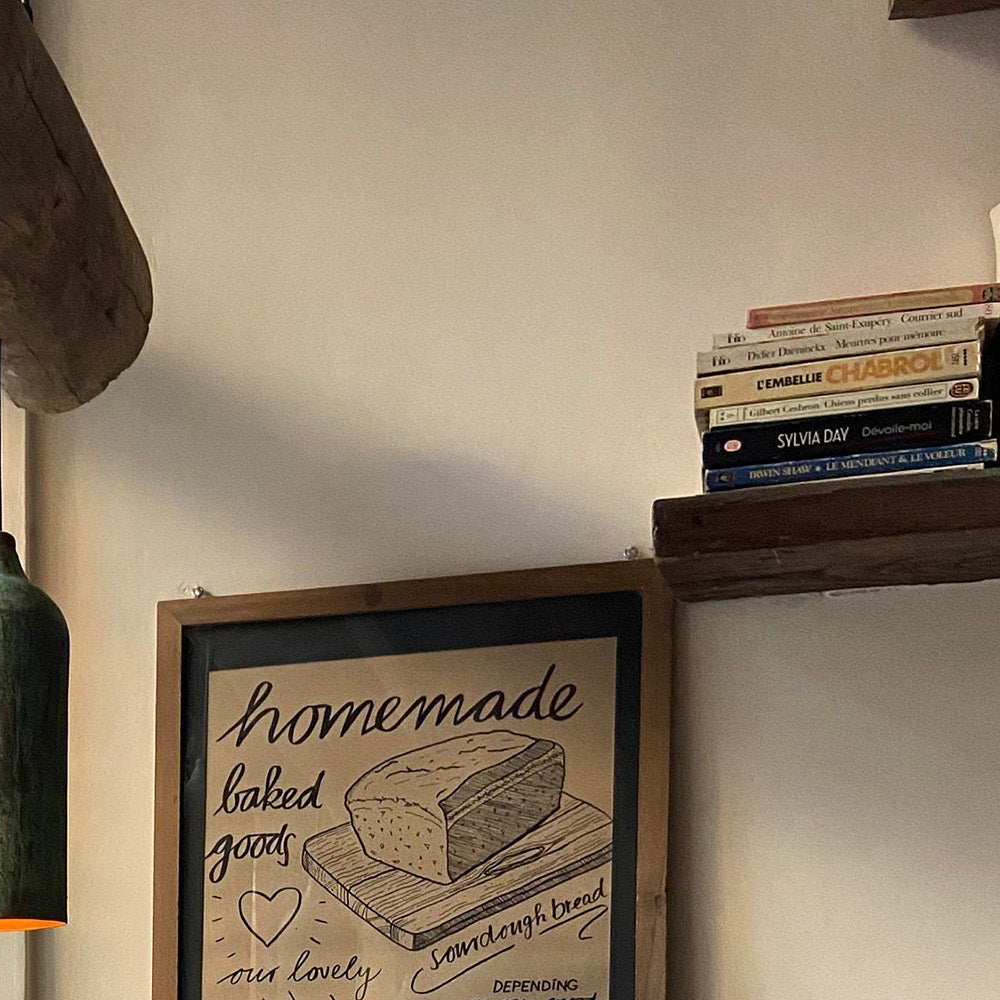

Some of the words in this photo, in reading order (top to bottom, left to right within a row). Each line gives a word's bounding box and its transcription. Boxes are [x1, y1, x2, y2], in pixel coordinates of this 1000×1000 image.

[769, 326, 805, 338] Antoine
[809, 324, 820, 335] de
[825, 318, 891, 333] Saint-Exupéry
[901, 311, 943, 323] Courrier
[946, 308, 963, 318] sud
[747, 350, 775, 361] Didier
[879, 335, 900, 346] pour
[757, 372, 823, 390] L'EMBELLIE
[825, 351, 943, 385] CHABROL
[749, 407, 780, 418] Gilbert
[824, 398, 855, 410] Chiens
[857, 392, 889, 408] perdus
[913, 387, 943, 398] collier
[777, 430, 820, 448] SYLVIA
[823, 426, 849, 443] DAY
[862, 421, 932, 437] Dévoile-moi
[749, 468, 780, 479] IRWIN
[782, 464, 812, 475] SHAW
[826, 461, 839, 471] LE
[841, 456, 895, 469] MENDIANT
[898, 455, 908, 464] &
[911, 453, 922, 462] LE
[925, 449, 966, 460] VOLEUR
[216, 664, 583, 748] homemade
[213, 762, 325, 816] baked
[205, 824, 296, 882] goods
[430, 903, 547, 971] sourdough
[551, 878, 608, 921] bread
[217, 962, 279, 985] our
[287, 950, 381, 1000] lovely
[492, 979, 578, 994] DEPENDING
